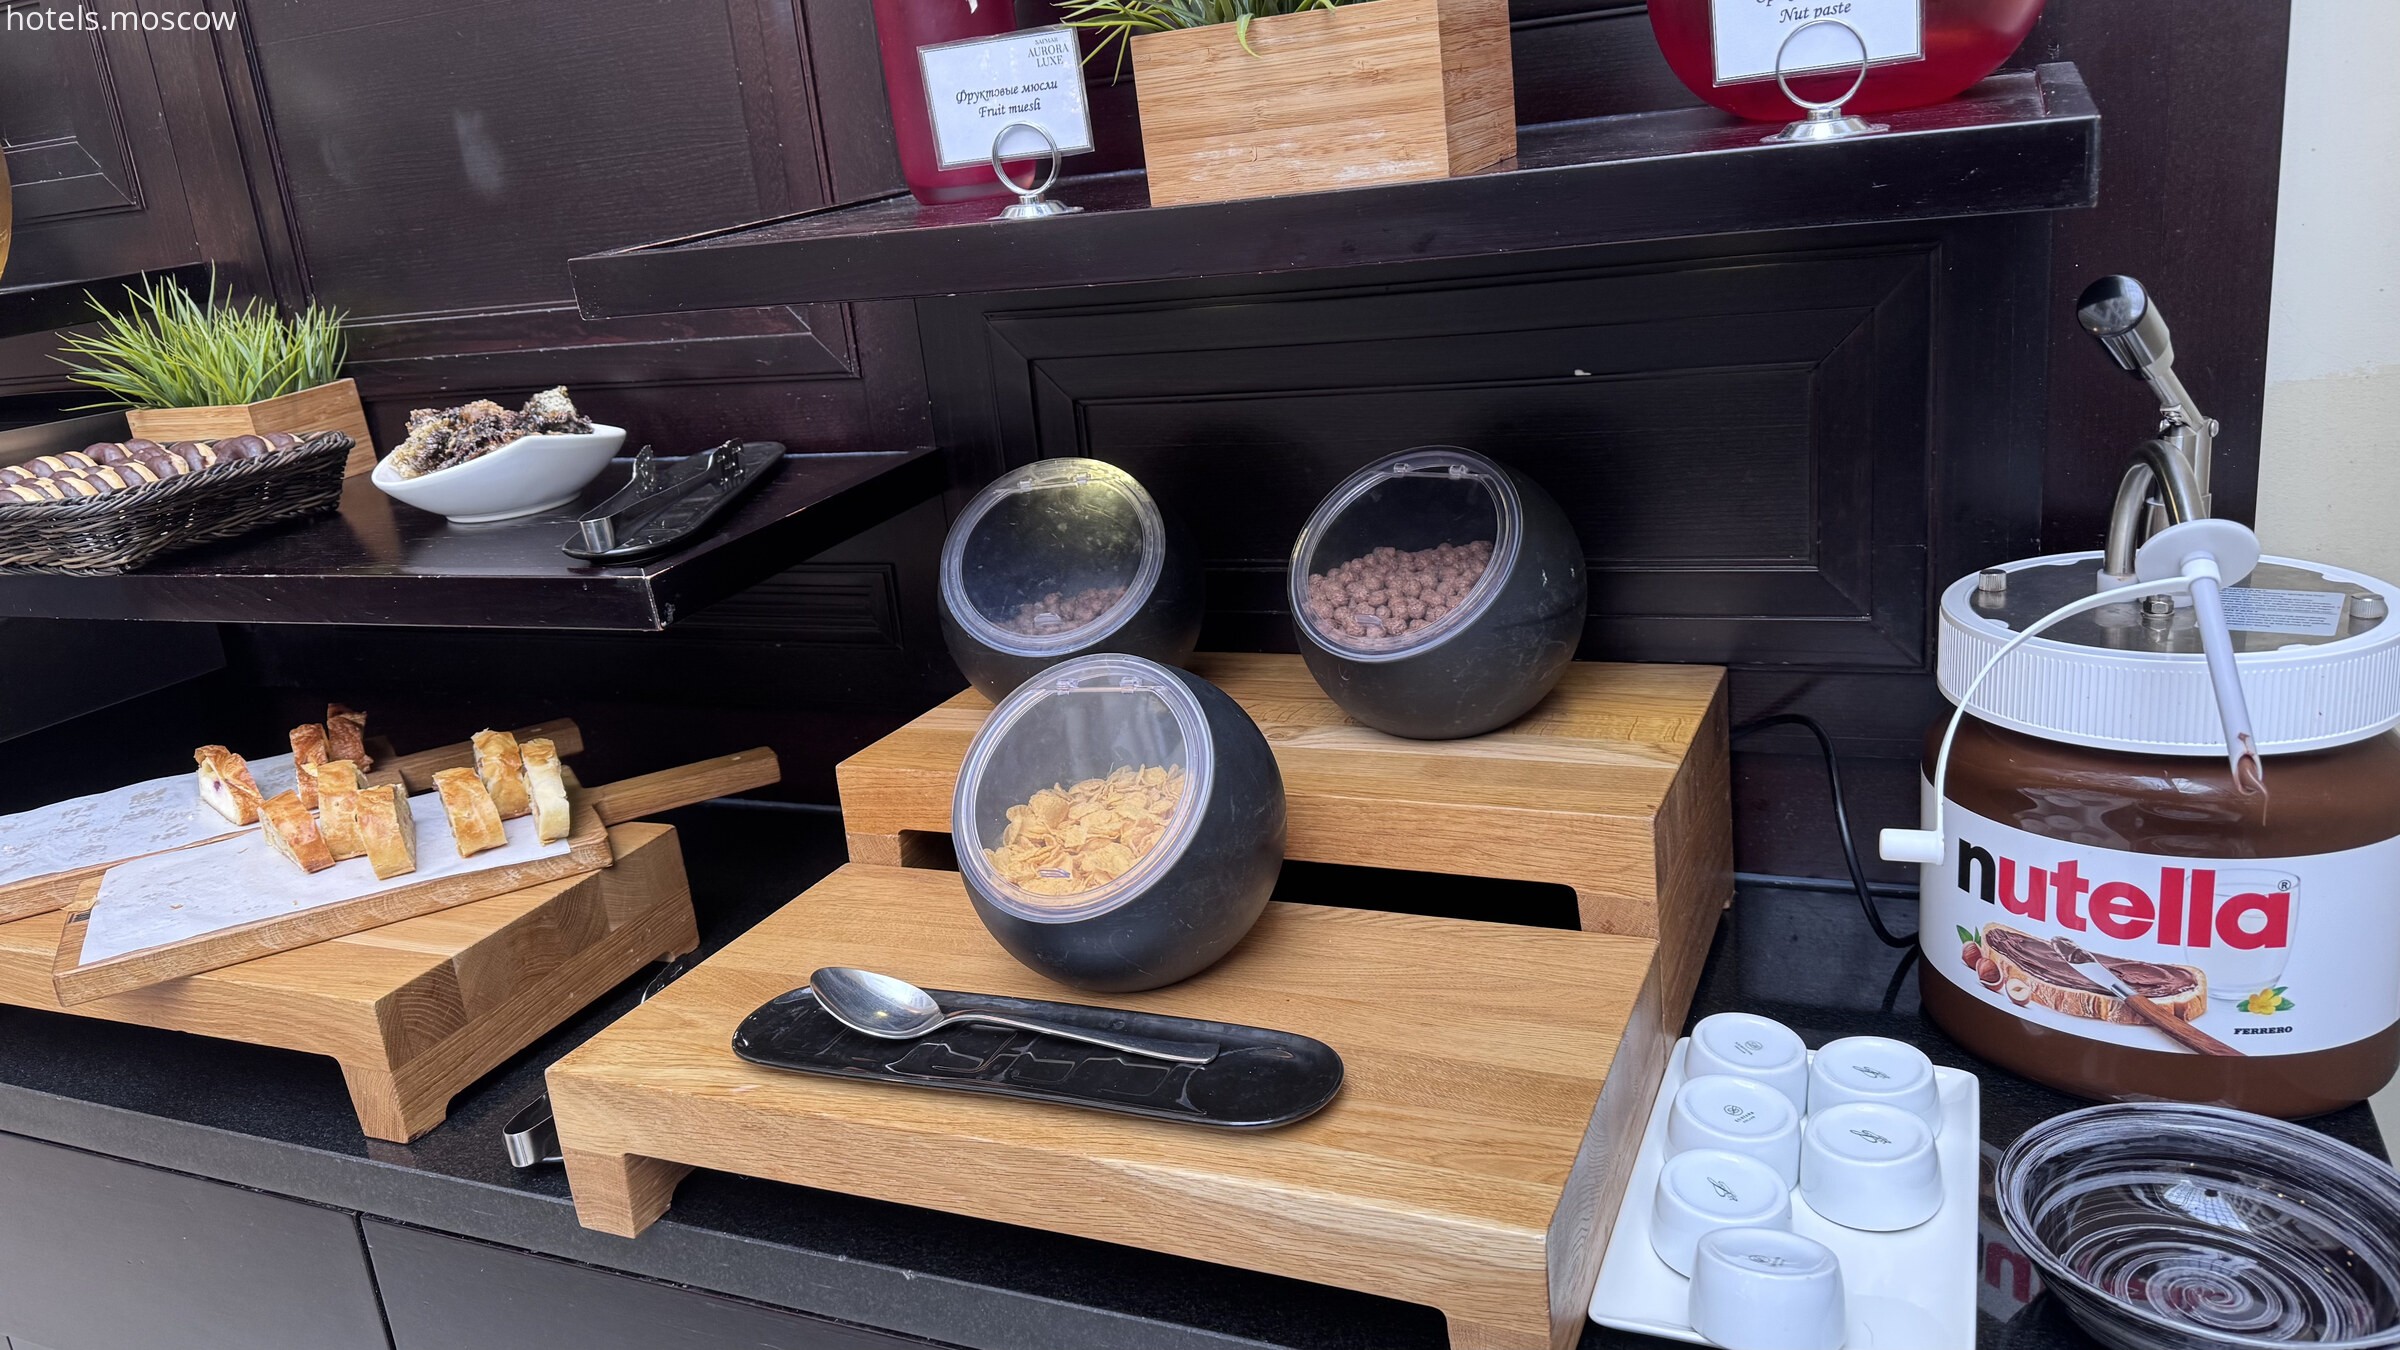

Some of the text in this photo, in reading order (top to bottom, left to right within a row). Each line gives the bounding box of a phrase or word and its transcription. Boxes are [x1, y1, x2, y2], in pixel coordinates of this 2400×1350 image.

[1779, 1, 1852, 24] Nut paste
[1027, 43, 1070, 58] AURORA
[1036, 54, 1064, 68] LUXE
[955, 80, 1058, 105] Фруктовые мюсли
[978, 97, 1042, 118] Fruit muesli
[1957, 836, 2292, 952] nutella
[2233, 1025, 2294, 1036] FERRERO
